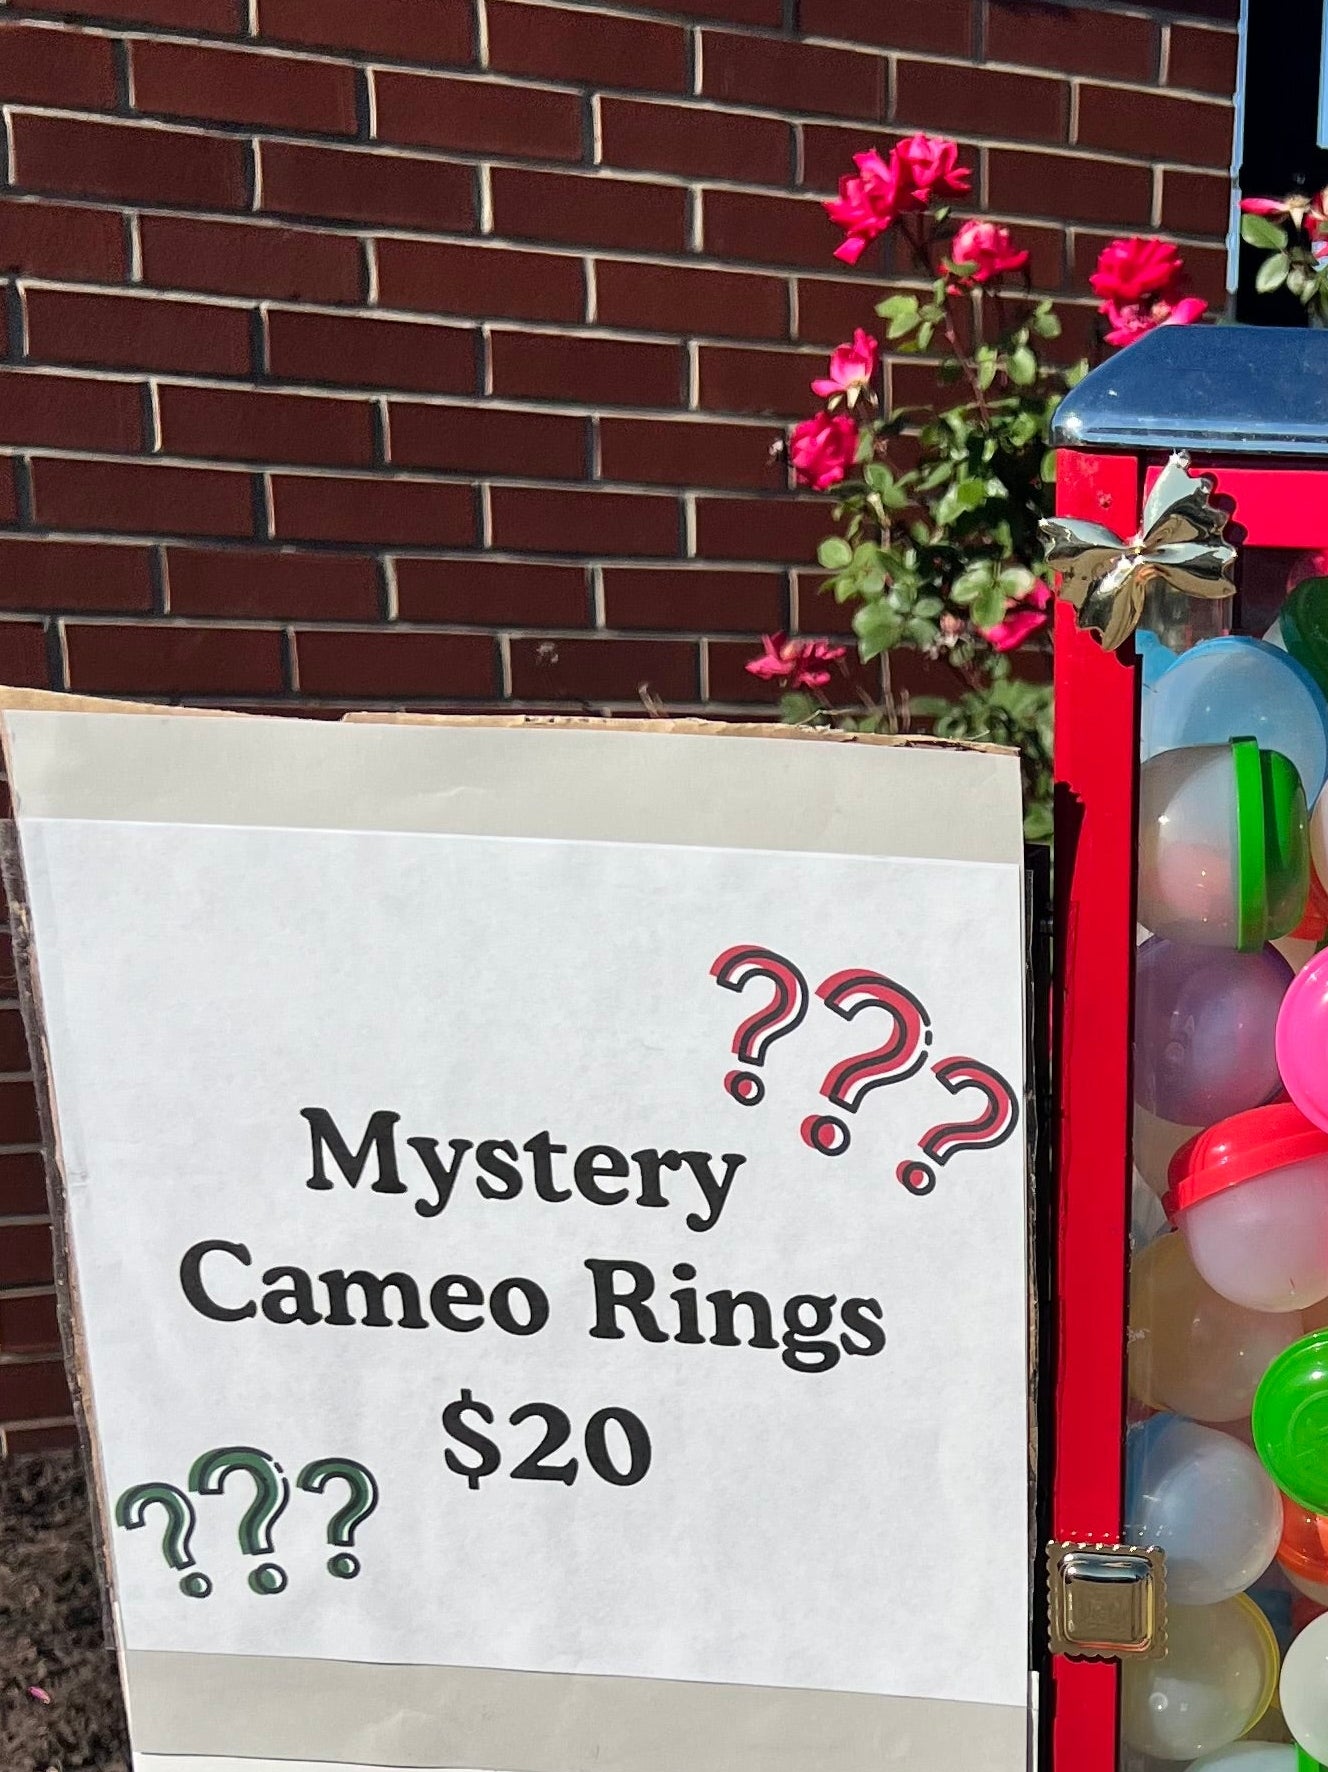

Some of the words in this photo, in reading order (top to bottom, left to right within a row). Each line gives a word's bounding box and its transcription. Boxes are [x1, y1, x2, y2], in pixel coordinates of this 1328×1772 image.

[300, 1106, 747, 1233] Mystery
[179, 1239, 550, 1336] Cameo
[583, 1258, 886, 1374] Rings
[441, 1388, 652, 1490] $20
